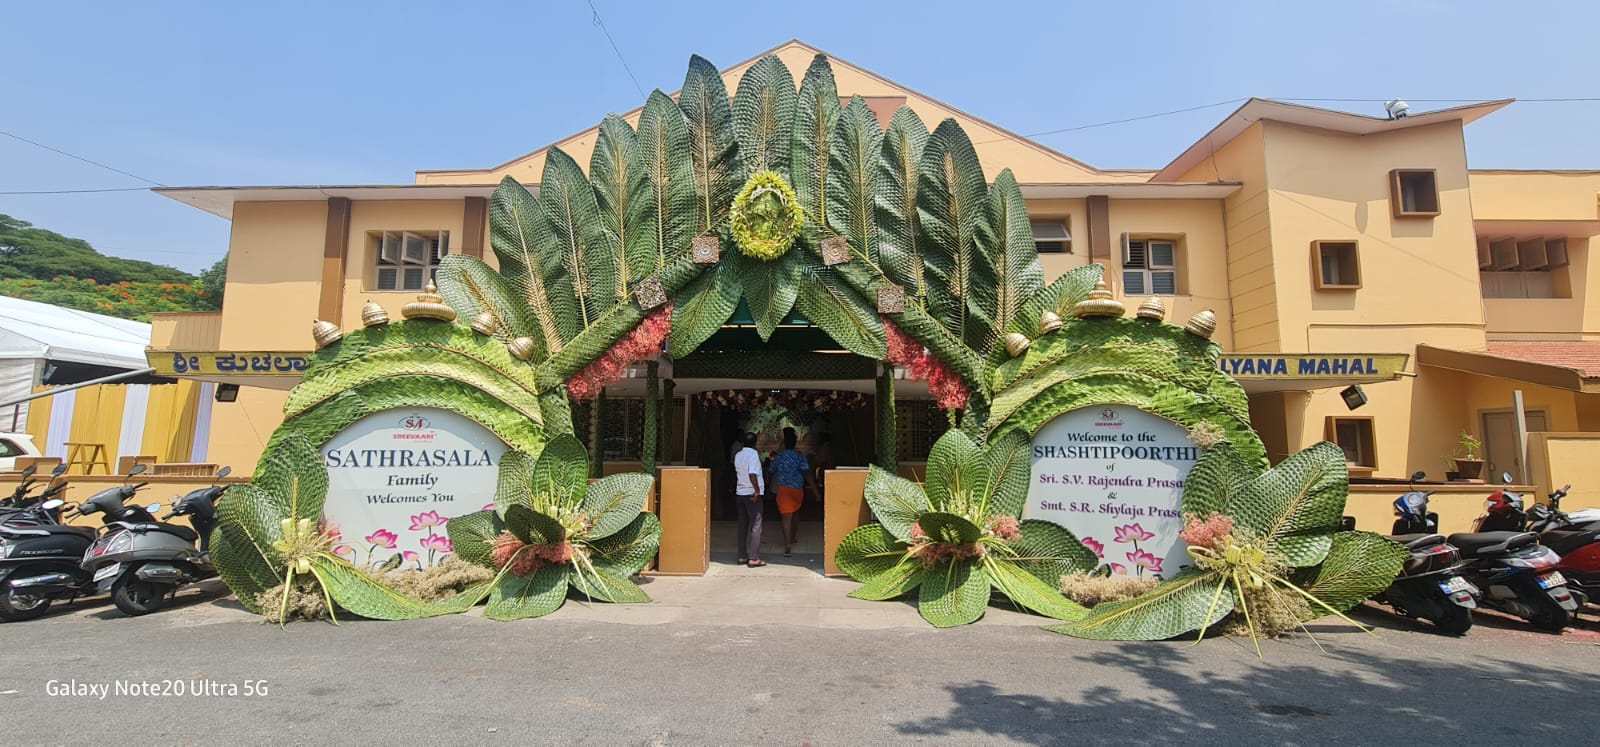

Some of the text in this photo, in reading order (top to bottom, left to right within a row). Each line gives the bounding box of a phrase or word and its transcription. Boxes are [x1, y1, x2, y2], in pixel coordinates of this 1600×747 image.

[215, 352, 308, 372] ಕುಚಲಾ
[1220, 358, 1378, 375] LYANA MAHAL
[1067, 432, 1157, 443] Welcome to the
[326, 449, 493, 468] SATHRASALA
[1034, 446, 1198, 460] SHASHTIPOORTHI
[1106, 463, 1115, 472] of
[388, 474, 438, 490] Family
[1039, 473, 1184, 490] Sri. S.V. Rajendra Prasa
[367, 493, 454, 505] Welcomes You
[1107, 491, 1118, 500] &
[1040, 500, 1066, 511] Smt.
[1069, 501, 1095, 513] S.R.
[1099, 503, 1144, 519] Shylaja
